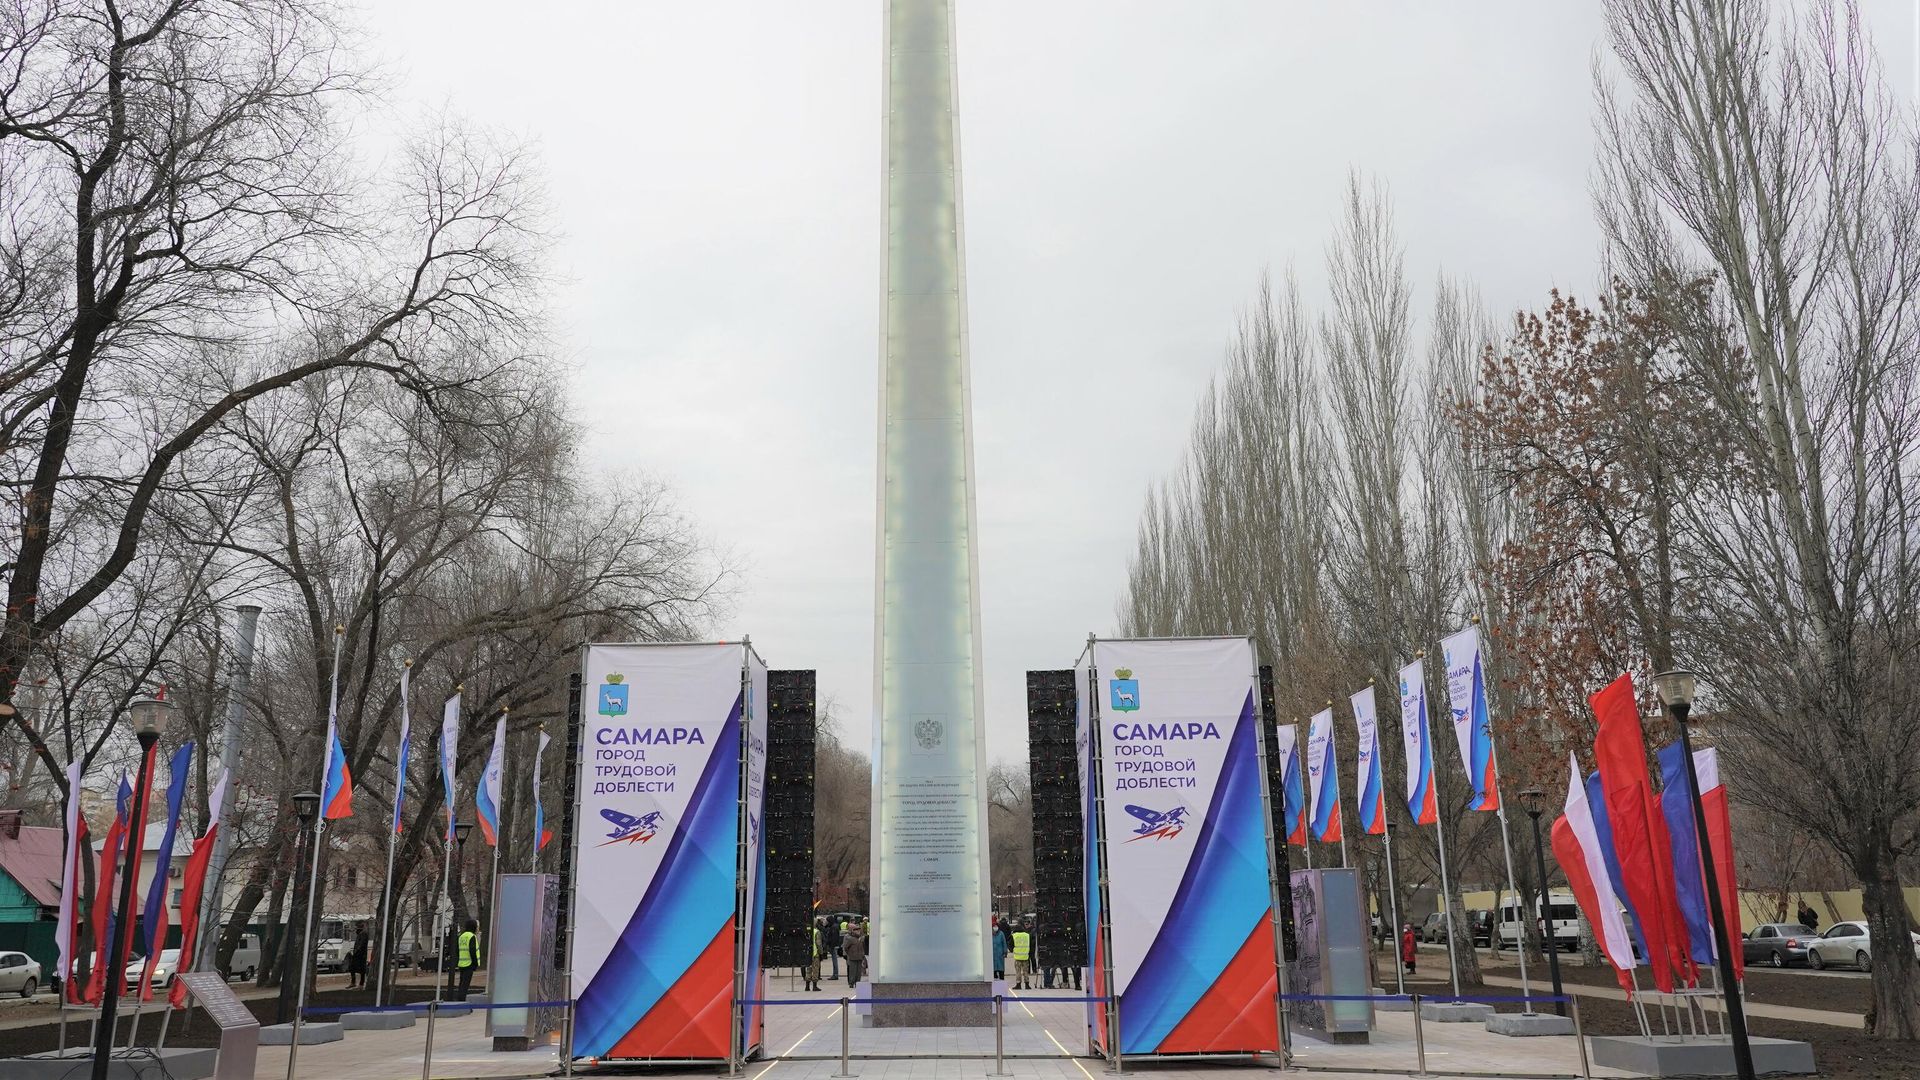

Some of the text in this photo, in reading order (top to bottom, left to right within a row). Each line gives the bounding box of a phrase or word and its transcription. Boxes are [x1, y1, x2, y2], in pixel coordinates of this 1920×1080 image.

[596, 727, 705, 746] САМАРА
[1113, 722, 1221, 741] САМАРА
[596, 749, 645, 762] ГОРОД
[1115, 745, 1164, 758] ГОРОД
[595, 763, 676, 778] ТРУДОВОЙ
[1115, 758, 1196, 773] ТРУДОВОЙ
[594, 781, 675, 795] ДОБЛЕСТИ
[1116, 777, 1196, 791] ДОБЛЕСТИ
